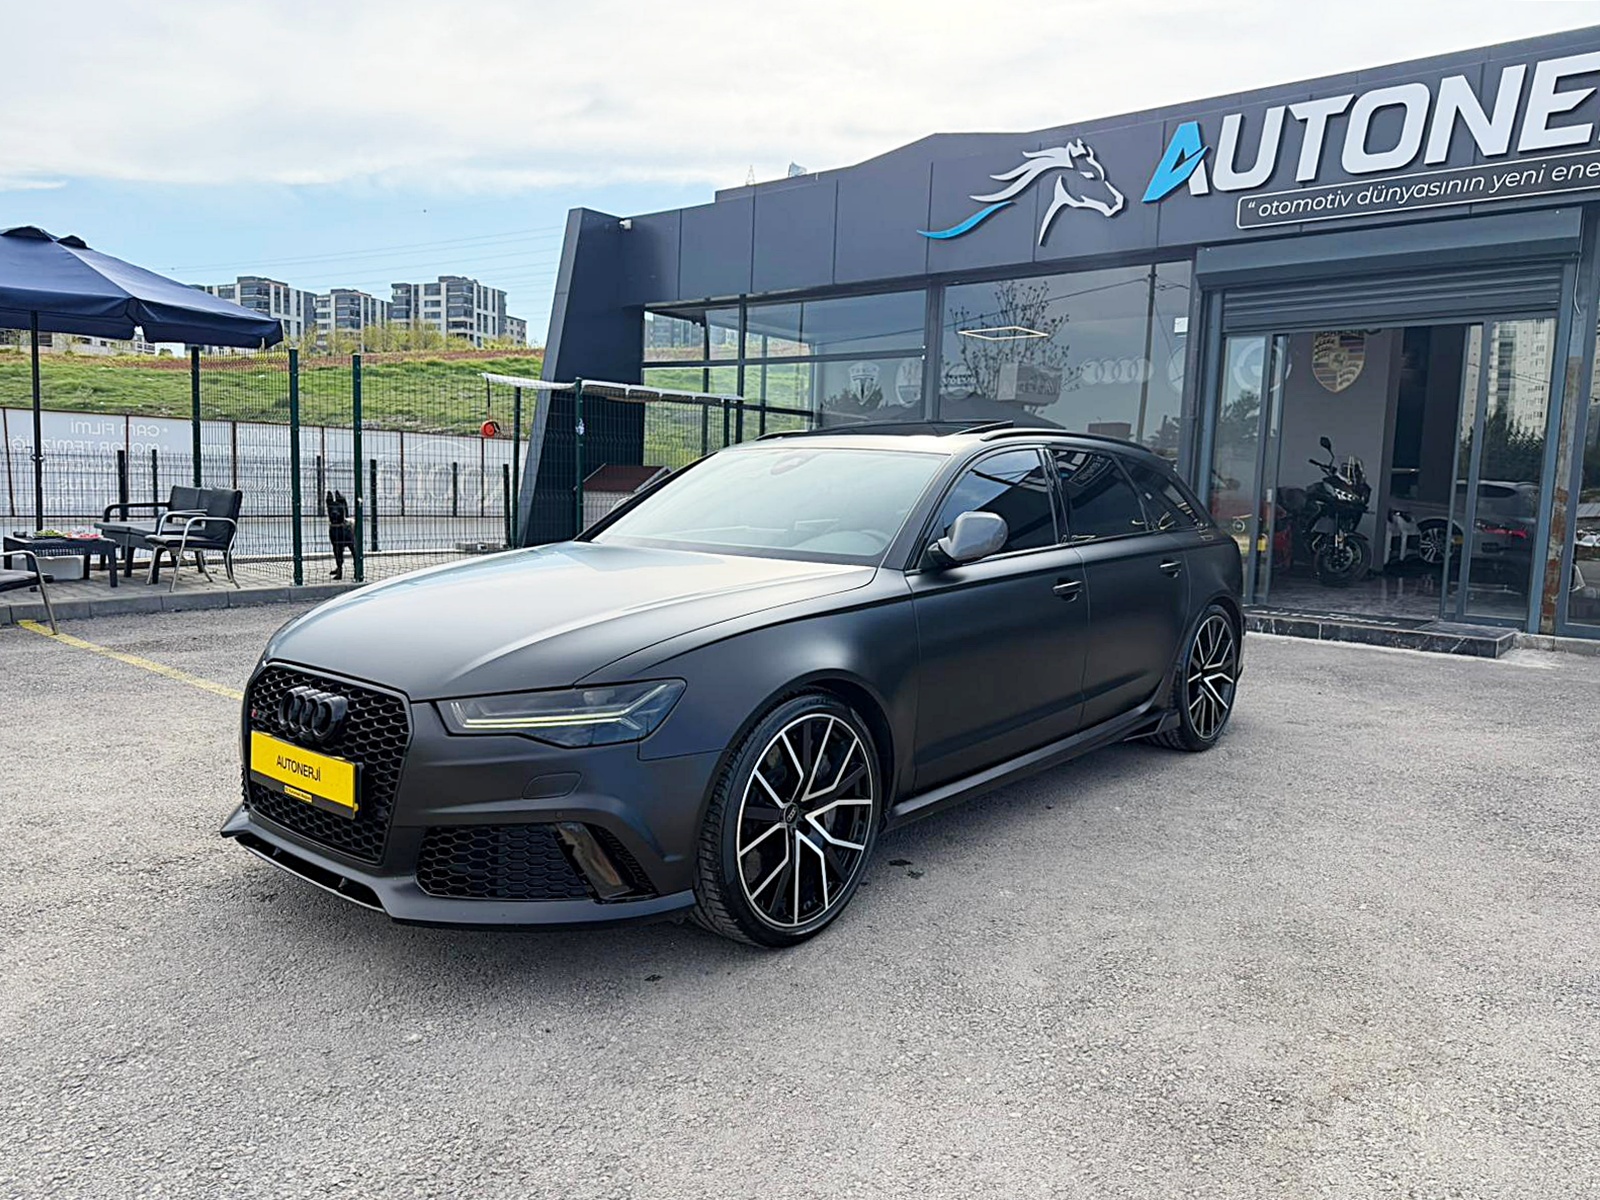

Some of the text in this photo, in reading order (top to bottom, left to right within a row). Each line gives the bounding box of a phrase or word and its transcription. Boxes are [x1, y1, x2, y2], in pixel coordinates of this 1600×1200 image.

[1142, 52, 1600, 203] AUTONE
[1355, 176, 1486, 206] dünyasının
[1487, 163, 1547, 195] yeni
[276, 754, 321, 782] AUTONERJİ
